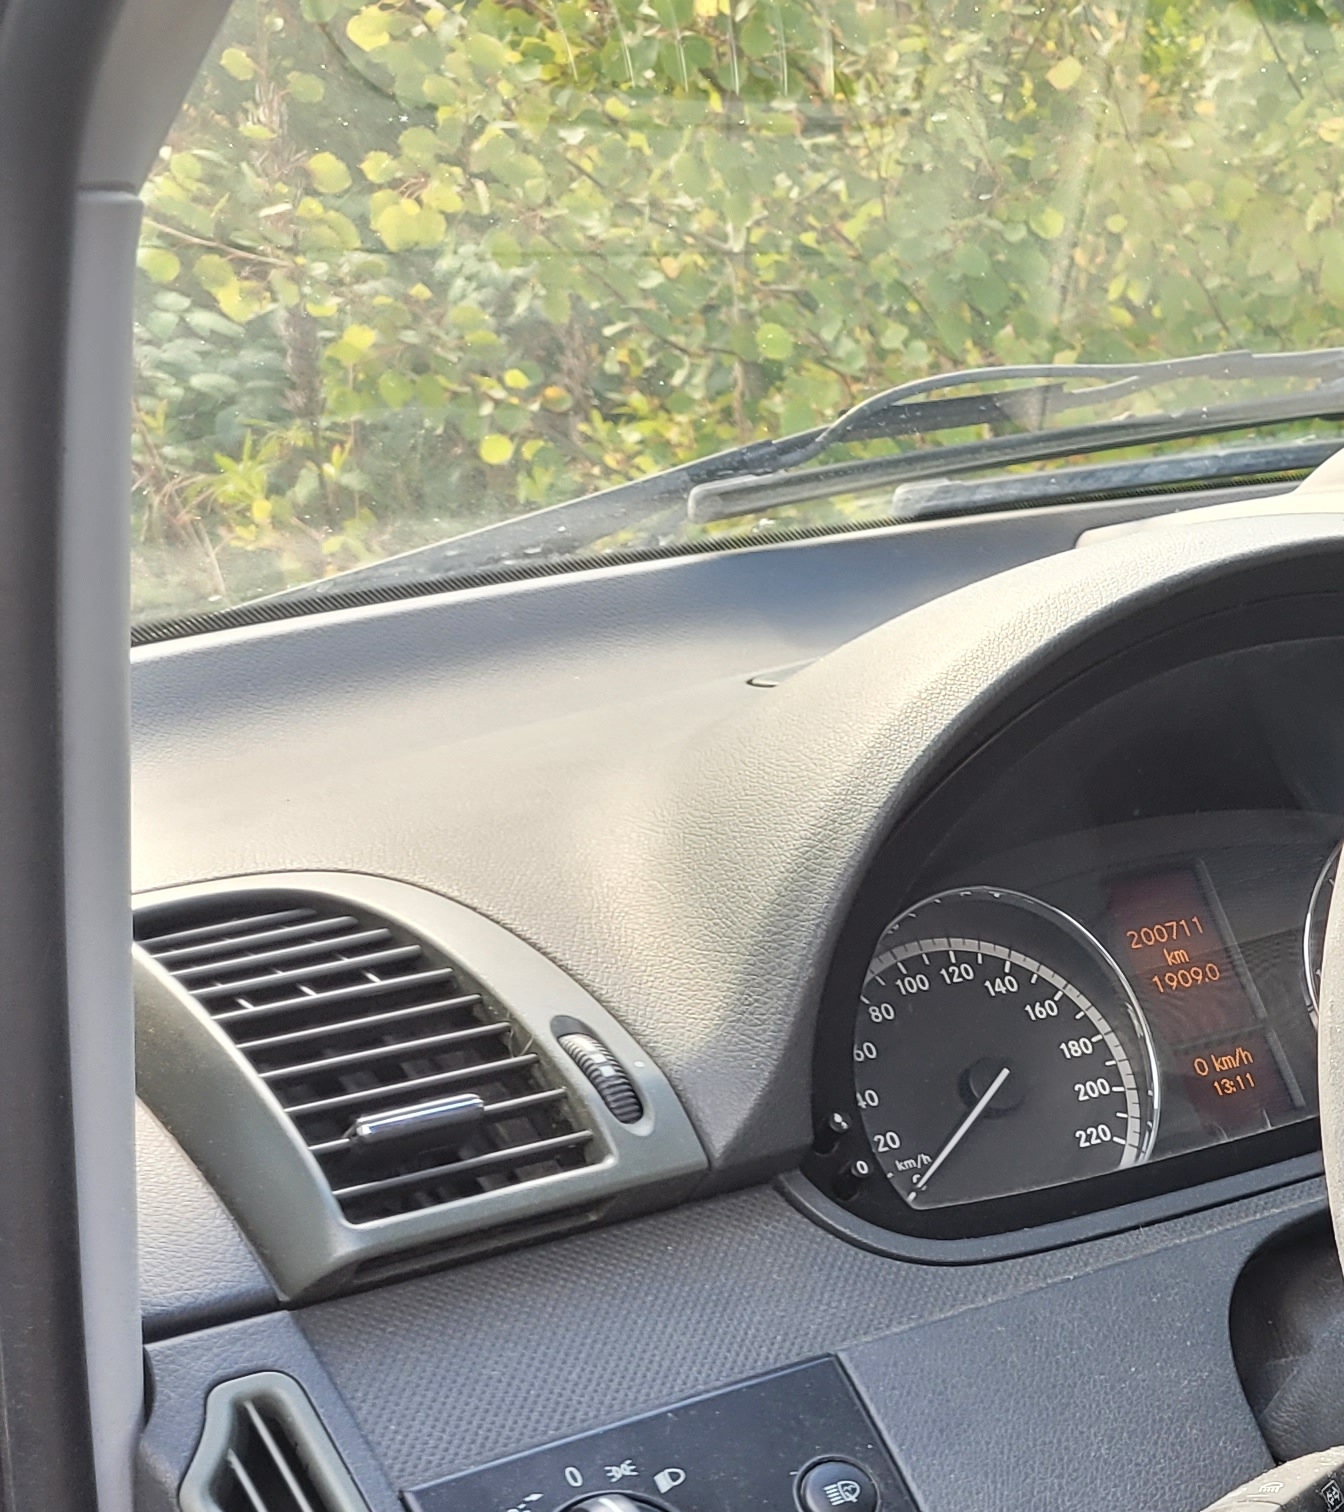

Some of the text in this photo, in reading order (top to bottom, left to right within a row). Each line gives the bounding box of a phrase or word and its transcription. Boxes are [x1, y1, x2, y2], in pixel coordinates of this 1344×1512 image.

[1126, 916, 1204, 949] 200711
[1163, 949, 1190, 966] km
[940, 963, 975, 984] 120
[1152, 963, 1221, 993] 1909.0
[895, 974, 930, 995] 100
[984, 975, 1019, 996] 140
[868, 1003, 895, 1023] 80
[1024, 999, 1059, 1021] 160
[853, 1042, 878, 1062] 60
[1059, 1037, 1094, 1059] 180
[1193, 1047, 1254, 1077] 0 km/h
[1074, 1078, 1111, 1101] 200
[1213, 1073, 1256, 1096] 13:11
[856, 1089, 879, 1109] 40
[873, 1131, 901, 1152] 20
[1075, 1124, 1112, 1148] 220
[895, 1153, 932, 1172] km/h
[564, 1466, 583, 1487] 0
